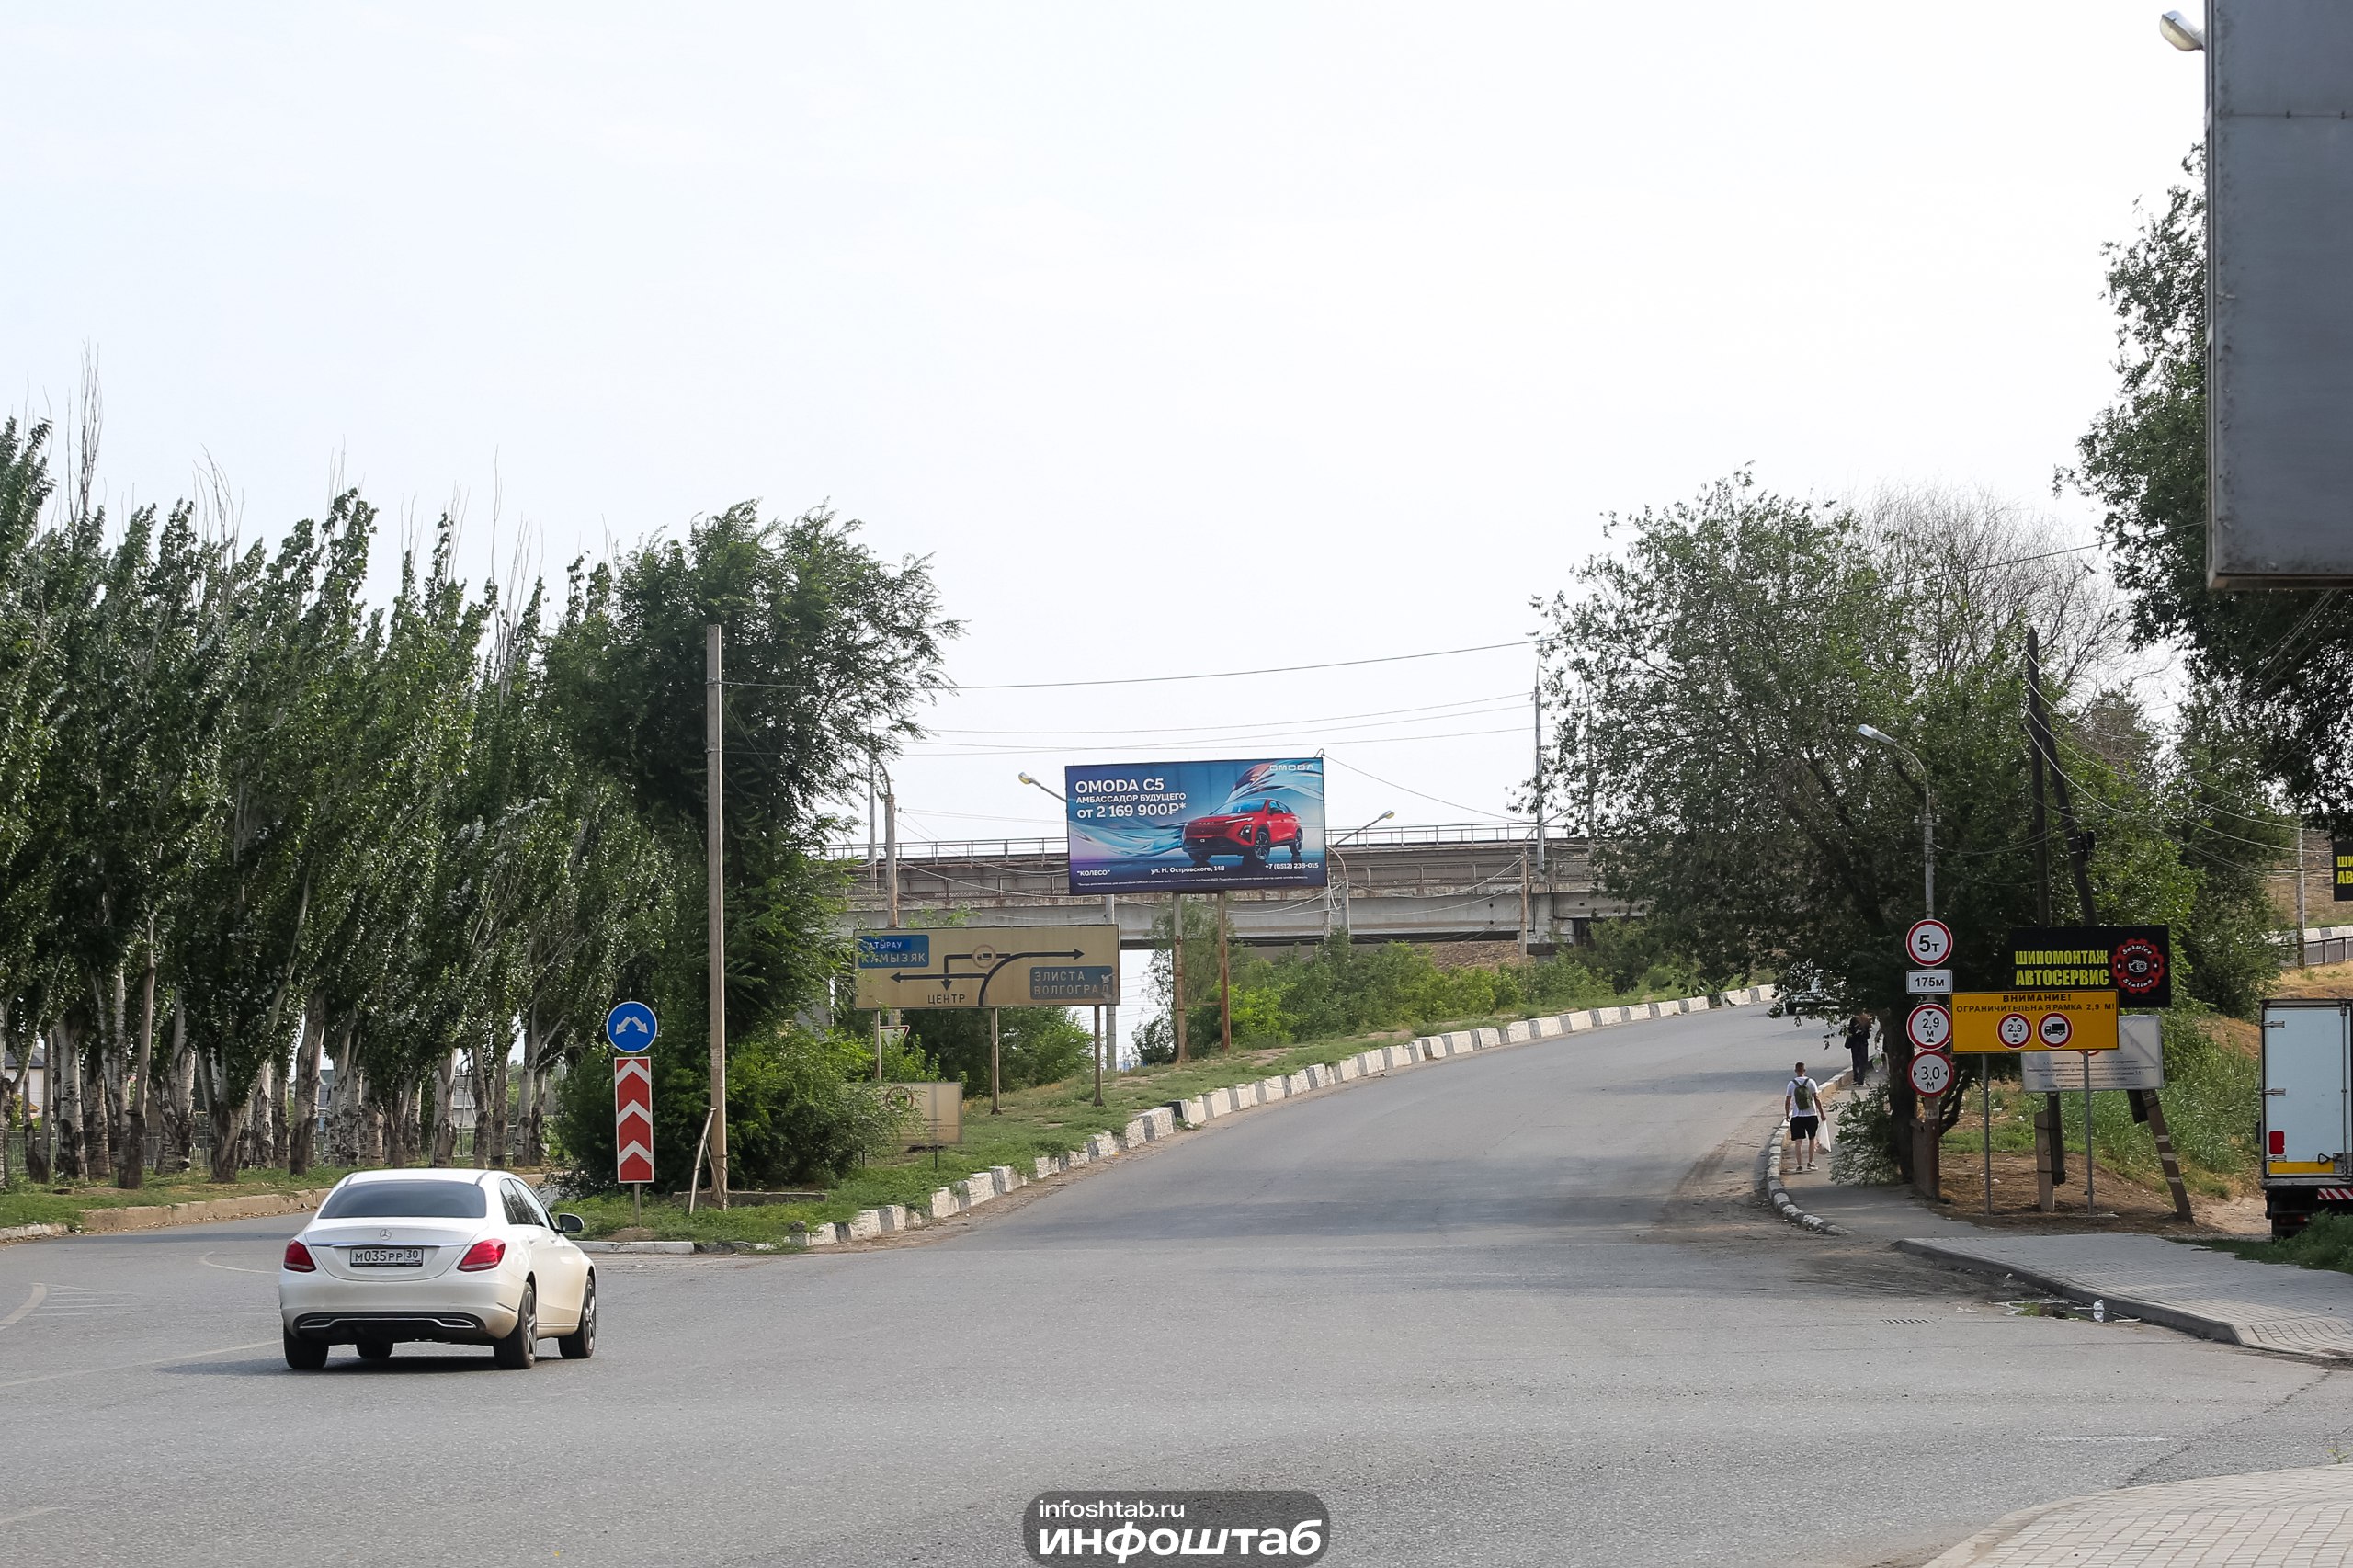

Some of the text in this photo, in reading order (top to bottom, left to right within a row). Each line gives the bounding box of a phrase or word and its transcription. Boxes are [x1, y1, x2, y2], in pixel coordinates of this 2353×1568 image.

[1269, 764, 1314, 772] OMODA
[1075, 778, 1165, 794] OMODA C5
[1076, 792, 1187, 804] АМБАССАДОР БУДУЩЕГО
[1076, 809, 1094, 819] от
[1096, 805, 1106, 818] 2
[1109, 804, 1133, 818] 169
[2122, 944, 2153, 955] Service
[2015, 950, 2109, 965] ШИНОМОНТАЖ
[1034, 971, 1086, 982] ЭЛИСТА
[2015, 969, 2109, 986] АВТОСЕРВИС
[2122, 978, 2153, 988] Station
[927, 994, 966, 1005] ЦЕНТР
[2002, 994, 2072, 1003] ВНИМАНИЕ!
[1956, 1004, 2052, 1013] ОГРАНИЧИТЕЛЬНАЯ
[2052, 1003, 2083, 1011] РАМКА
[1922, 1017, 1940, 1029] 2,9
[355, 1249, 419, 1262] М035РР 30
